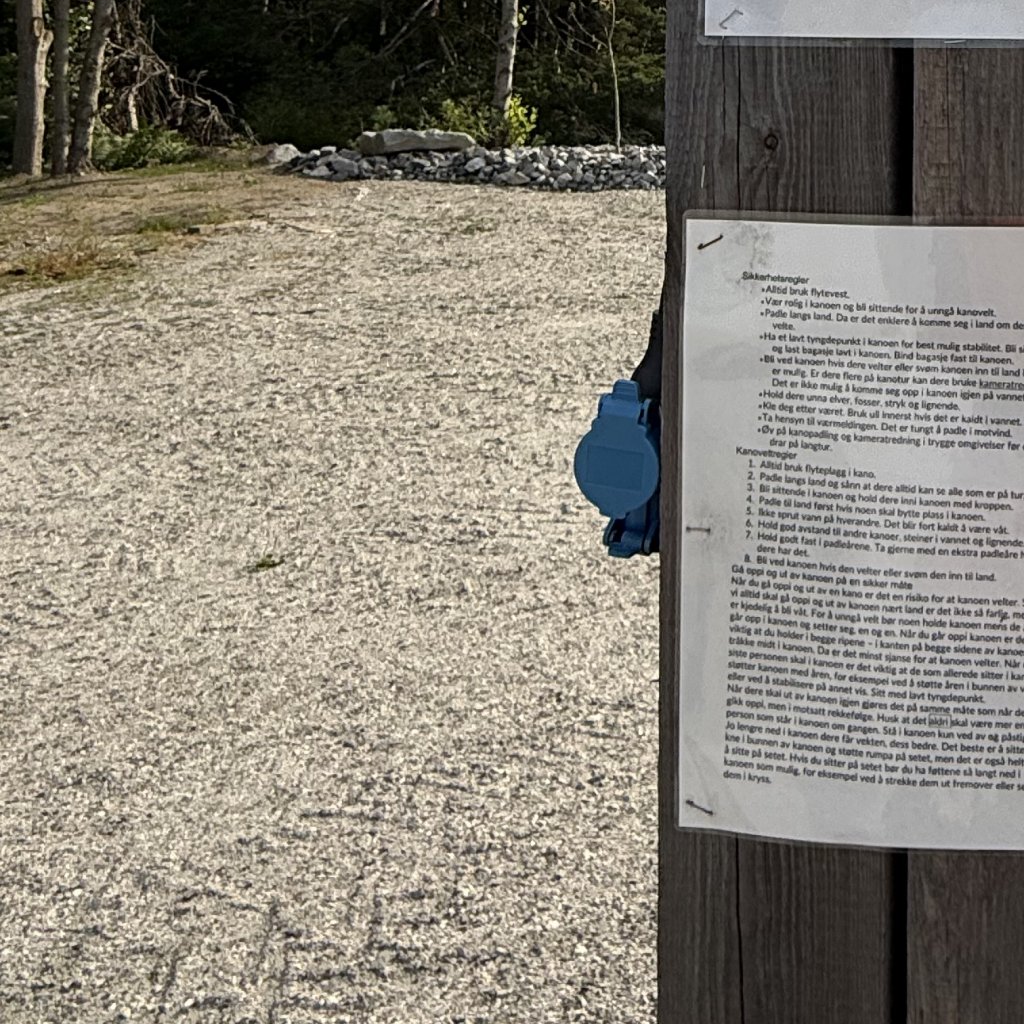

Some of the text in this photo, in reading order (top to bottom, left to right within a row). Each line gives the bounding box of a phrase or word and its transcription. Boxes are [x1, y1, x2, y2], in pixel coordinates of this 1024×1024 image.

[783, 298, 803, 309] rolig
[809, 299, 841, 309] kanoen
[842, 303, 854, 313] og
[855, 302, 866, 311] bli
[868, 303, 903, 313] sittende
[904, 304, 918, 314] for
[927, 306, 954, 317] unngå
[777, 333, 787, 341] et
[788, 332, 805, 342] lavt
[867, 337, 899, 347] kanoen
[900, 338, 913, 348] for
[915, 339, 935, 349] best
[936, 341, 960, 352] mulig
[1004, 343, 1016, 352] Bli
[776, 355, 793, 364] ved
[794, 356, 826, 366] kanoen
[827, 357, 845, 367] hvis
[846, 359, 866, 368] dere
[867, 360, 892, 370] velter
[894, 361, 913, 371] eller
[940, 364, 973, 374] kanoen
[974, 365, 989, 375] inn
[990, 366, 999, 375] til
[1001, 367, 1020, 376] land
[777, 402, 794, 414] deg
[795, 404, 816, 413] etter
[846, 407, 867, 417] Bruk
[868, 408, 880, 418] ull
[881, 409, 911, 420] innerst
[913, 411, 931, 421] hvis
[933, 412, 948, 422] det
[961, 414, 983, 424] kaldt
[759, 472, 782, 482] Padle
[784, 474, 806, 486] langs
[807, 476, 826, 486] land
[827, 480, 839, 489] og
[840, 479, 861, 489] sånn
[862, 482, 871, 490] at
[872, 481, 893, 491] dere
[894, 483, 916, 493] alltid
[917, 484, 934, 494] kan
[947, 486, 963, 496] alle
[964, 489, 984, 497] som
[996, 489, 1008, 500] på
[757, 507, 776, 517] Ikke
[777, 511, 799, 521] sprut
[800, 514, 822, 522] vann
[823, 514, 834, 525] på
[883, 518, 900, 528] Det
[901, 519, 916, 529] blir
[918, 520, 935, 530] fort
[936, 522, 959, 531] kaldt
[968, 525, 991, 533] være
[728, 636, 755, 647] tråkke
[756, 639, 775, 649] midt
[816, 645, 830, 655] Da
[841, 648, 857, 657] det
[858, 650, 882, 660] minst
[884, 651, 911, 663] sjanse
[912, 653, 927, 663] for
[927, 656, 937, 664] at
[938, 655, 972, 666] kanoen
[1003, 659, 1020, 668] Når
[726, 682, 742, 693] Når
[744, 685, 763, 695] dere
[765, 688, 782, 698] skal
[783, 691, 792, 699] ut
[794, 693, 804, 701] av
[806, 693, 838, 704] kanoen
[838, 696, 860, 708] igjen
[861, 698, 888, 710] gjøres
[889, 700, 904, 710] det
[906, 702, 917, 713] på
[919, 705, 951, 713] samme
[952, 705, 975, 715] måte
[977, 708, 996, 716] som
[997, 707, 1013, 716] når
[725, 719, 735, 729] Jo
[736, 721, 763, 734] lengre
[764, 726, 781, 735] ned
[787, 728, 819, 740] kanoen
[819, 731, 839, 742] dere
[841, 733, 854, 743] får
[888, 738, 909, 748] dess
[941, 741, 958, 751] Det
[959, 742, 984, 752] beste
[1005, 745, 1024, 754] sitte
